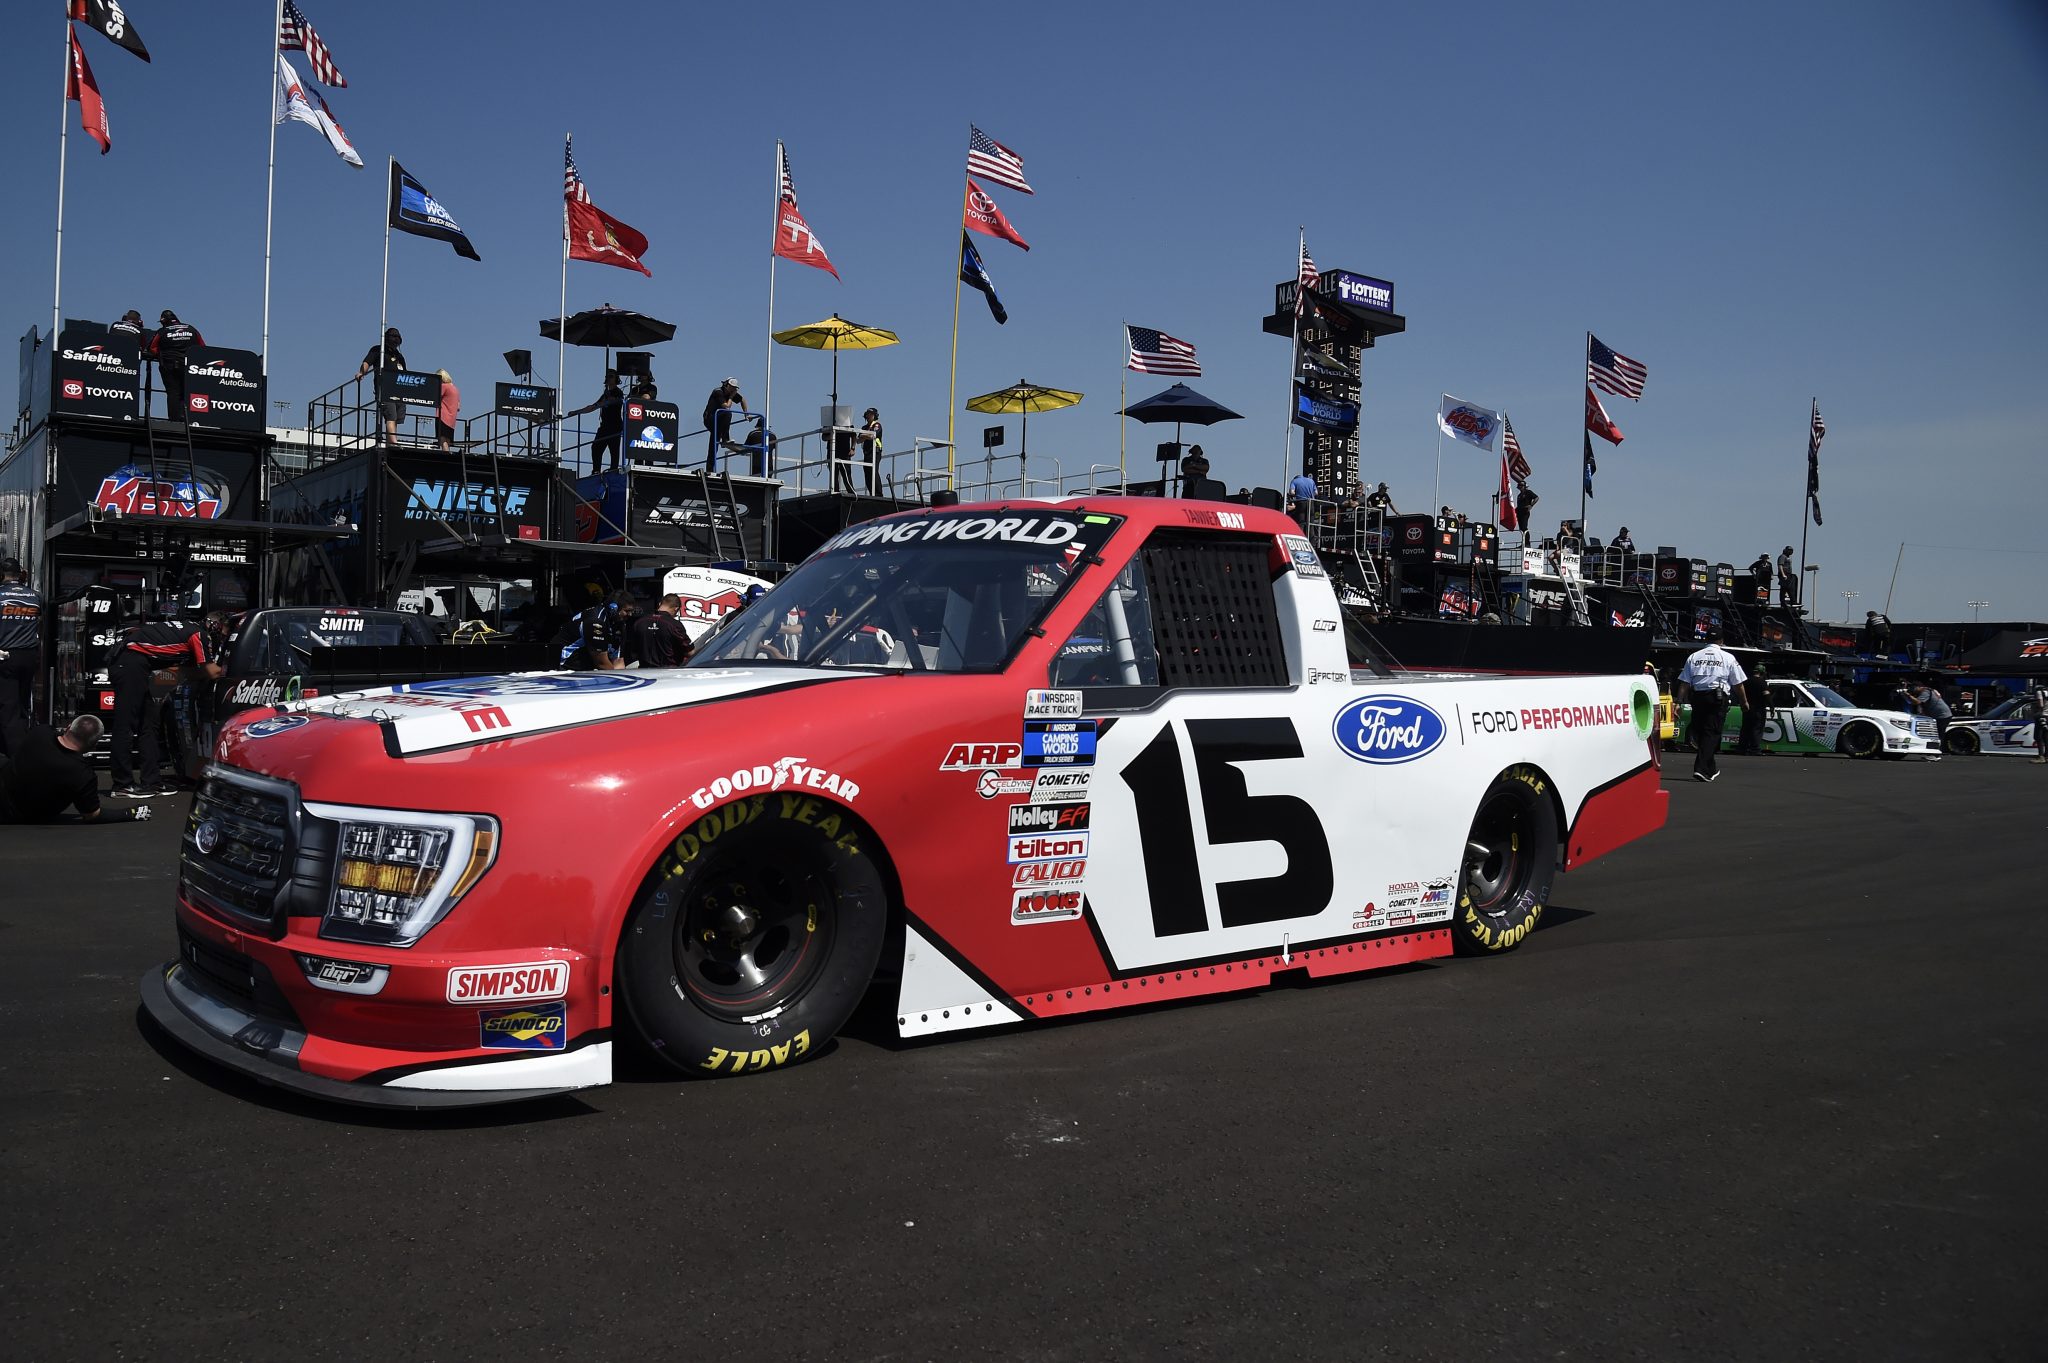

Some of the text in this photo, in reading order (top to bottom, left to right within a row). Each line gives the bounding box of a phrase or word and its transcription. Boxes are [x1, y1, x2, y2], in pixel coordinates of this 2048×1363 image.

[966, 208, 998, 225] TOYOTA
[1351, 281, 1390, 302] LOTTERY
[1351, 294, 1389, 308] TENNESSEE
[167, 331, 193, 339] Safelite
[62, 349, 123, 366] Safelite
[95, 364, 138, 376] AutoGlass
[188, 364, 244, 380] Safelite
[218, 378, 258, 389] AutoGlass
[396, 374, 428, 386] NIECE
[86, 386, 134, 401] TOYOTA
[509, 387, 538, 399] NIECE
[210, 400, 256, 413] TOYOTA
[402, 397, 435, 405] CHEVROLET
[645, 409, 677, 420] TOYOTA
[1312, 407, 1342, 420] WORLD
[1445, 408, 1491, 442] KBM
[633, 440, 665, 450] HALMAR
[1308, 442, 1314, 450] 7
[1337, 440, 1343, 448] 7
[1308, 458, 1314, 466] 8
[1337, 456, 1342, 464] 8
[1336, 471, 1342, 480] 9
[406, 479, 531, 516] NIECE
[1334, 487, 1344, 496] 10
[95, 477, 223, 520] KBM
[404, 509, 496, 526] MOTORSPORTS
[1182, 509, 1245, 530] TANNER GRAY
[922, 518, 1078, 545] WORLD
[1287, 539, 1312, 551] BUILT
[1525, 550, 1543, 558] HRE
[1562, 555, 1580, 564] HRE
[1297, 563, 1323, 575] TOUGH
[1528, 588, 1567, 605] HRE
[2, 606, 39, 616] GMS
[93, 600, 112, 613] 18
[319, 617, 364, 632] SMITH
[1318, 672, 1348, 683] FACTORY
[231, 678, 281, 706] Safelite
[1045, 693, 1076, 703] NASCAR
[1028, 705, 1078, 714] RACE TRUCK
[1471, 704, 1630, 734] FORD PERFORMANCE
[1053, 724, 1077, 732] NASCAR
[1356, 704, 1425, 752] Ford
[1042, 733, 1079, 744] CAMPING
[944, 744, 1022, 766] ARP
[1042, 742, 1079, 755] WORLD
[1037, 773, 1090, 787] COMETIC
[1501, 763, 1546, 797] EAGLE
[1010, 805, 1089, 830] Holley EFI
[1119, 716, 1334, 938] 15
[1014, 838, 1084, 859] tilton
[1013, 860, 1087, 885] CALICO
[1050, 878, 1084, 886] COATINGS
[1388, 881, 1420, 892] HONDA
[1018, 891, 1081, 914] KOOKS
[1388, 897, 1419, 908] COMETIC
[1420, 889, 1451, 903] HMS
[1419, 900, 1448, 909] motorsport
[1353, 910, 1369, 919] Gear
[1386, 910, 1412, 920] LINCOLN
[1416, 910, 1448, 919] SCHROTH
[1352, 919, 1385, 930] CROSLEY
[456, 967, 559, 999] SIMPSON
[485, 1016, 563, 1034] SUNOCO
[700, 1028, 811, 1074] EAGLE
